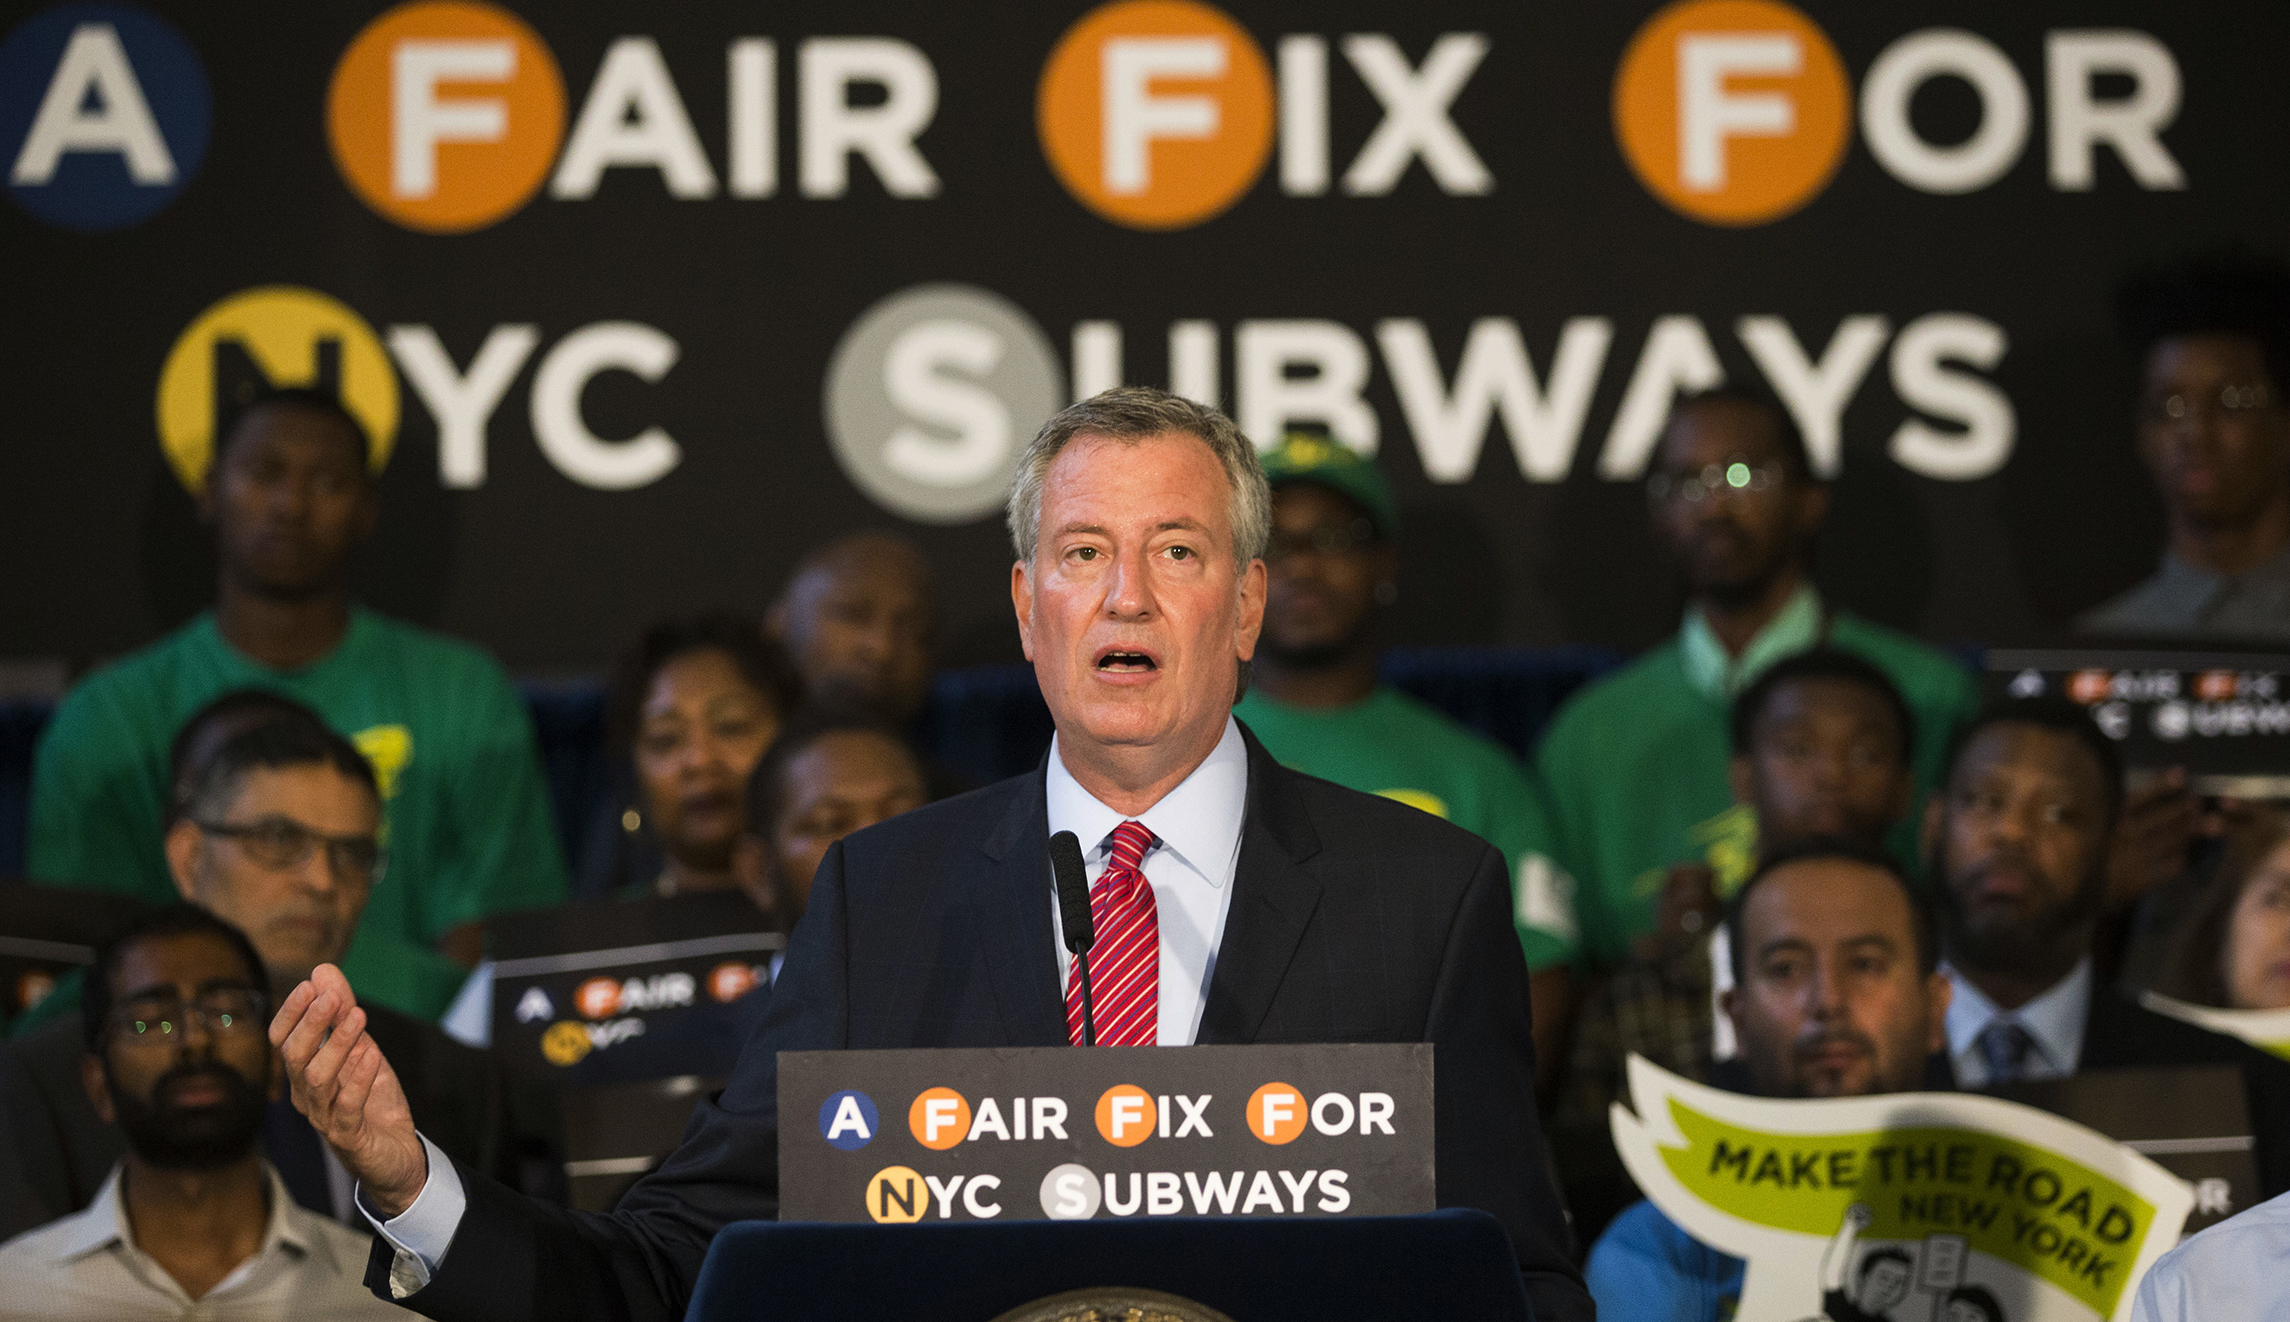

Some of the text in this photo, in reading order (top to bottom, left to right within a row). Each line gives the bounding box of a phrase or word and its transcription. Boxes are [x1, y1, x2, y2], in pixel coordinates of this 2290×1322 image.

[8, 22, 2187, 199] A FAIR FIX FOR
[584, 972, 696, 1018] FAIR
[827, 1092, 1396, 1141] A FAIR FIX FOR
[879, 1168, 1351, 1219] NYC SUBWAYS
[1709, 1138, 1860, 1190] MAKE
[1869, 1144, 1976, 1184] THE
[1987, 1154, 2136, 1246] ROAD
[1901, 1195, 1999, 1231] NEW
[2011, 1213, 2117, 1289] YORK
